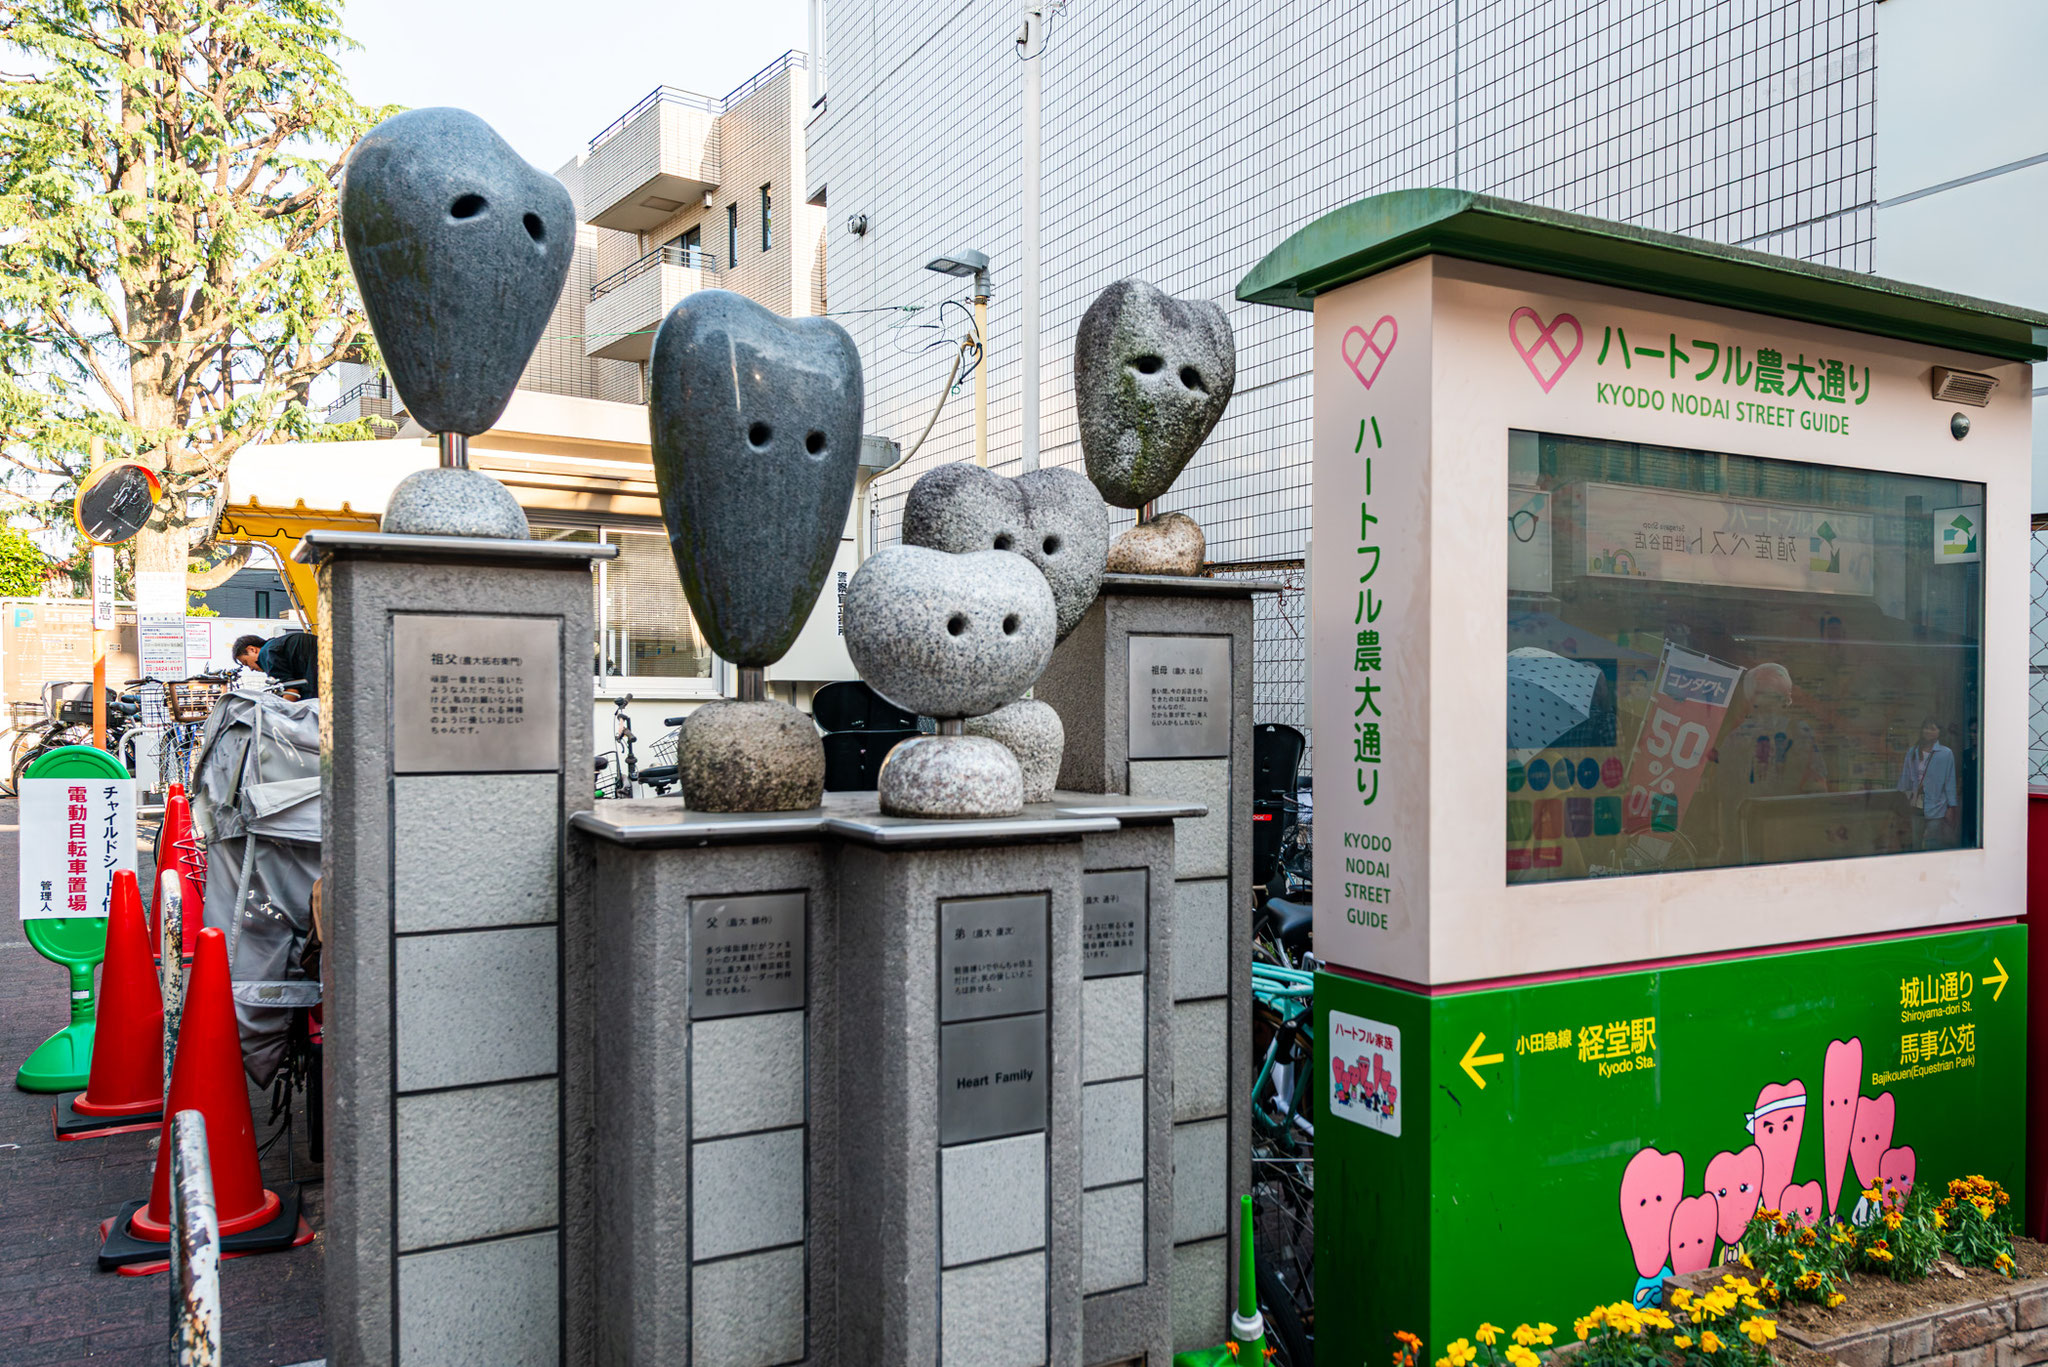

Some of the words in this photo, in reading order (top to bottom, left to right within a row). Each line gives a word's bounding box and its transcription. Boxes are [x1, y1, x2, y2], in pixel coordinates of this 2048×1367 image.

[1597, 326, 1870, 405] ハートフル農大通り
[1597, 382, 1664, 411] KYODO
[1672, 392, 1730, 420] NODAI
[1736, 401, 1795, 428] STREET
[1800, 410, 1849, 435] GUIDE
[98, 575, 112, 620] 注意
[1354, 416, 1382, 806] ハートフル農大通り
[15, 609, 33, 627] P
[1152, 665, 1168, 675] 祖母
[1668, 672, 1725, 697] コンタクト
[1646, 708, 1709, 769] 50
[1649, 761, 1675, 793] %
[1628, 785, 1678, 824] OFF
[67, 786, 87, 912] 電動自転車置場
[1344, 832, 1392, 852] KYODO
[1345, 858, 1389, 879] NODAI
[40, 880, 52, 912] 管理人
[1344, 882, 1391, 904] STREET
[707, 917, 718, 929] 父
[1346, 908, 1388, 930] GUIDE
[955, 928, 966, 940] 弟
[1900, 970, 1974, 1009] 城山通り
[1901, 1002, 1960, 1023] Shiroyama-dori
[1961, 1000, 1973, 1012] St.
[1335, 1023, 1394, 1052] ハートフル家族
[1516, 1028, 1572, 1055] 小田急線
[1578, 1016, 1656, 1063] 経堂駅
[1900, 1022, 1976, 1066] 馬事公苑
[1598, 1059, 1633, 1079] Kyodo
[1635, 1055, 1656, 1070] Sta.
[1955, 1054, 1975, 1069] Park)
[956, 1075, 989, 1090] Heart
[995, 1069, 1034, 1084] Family
